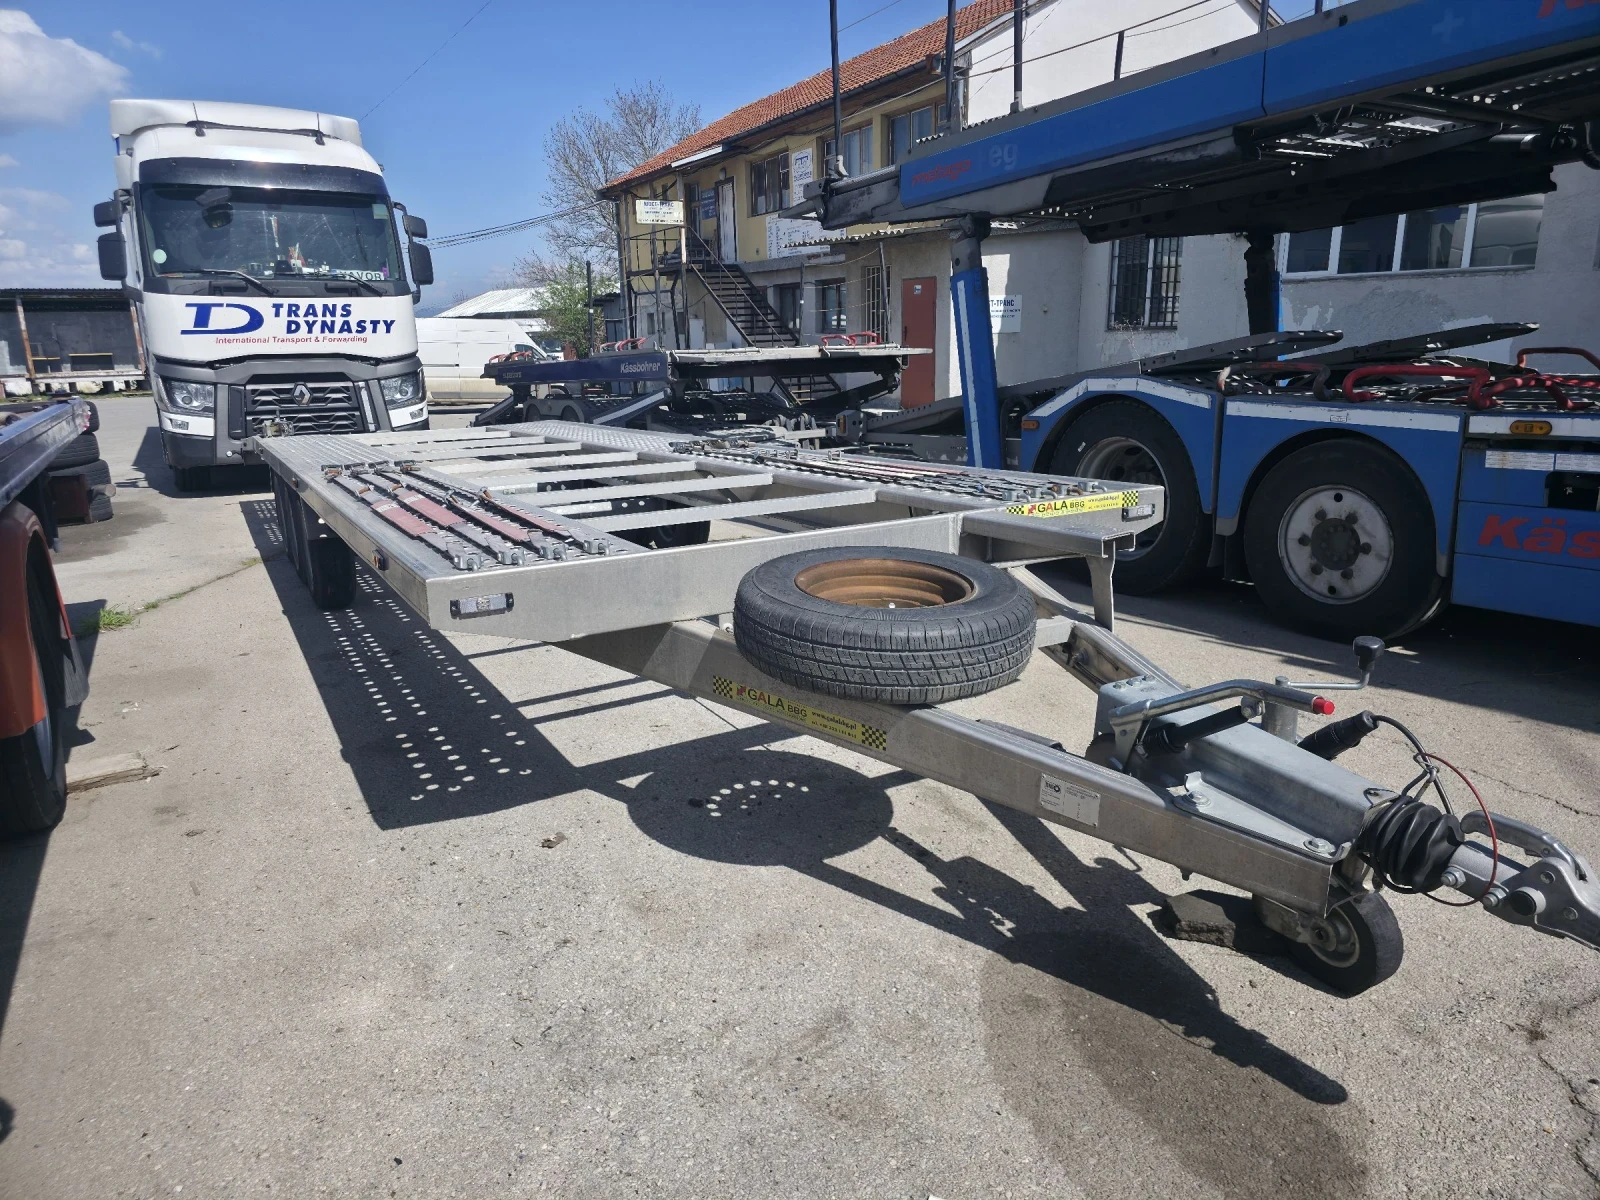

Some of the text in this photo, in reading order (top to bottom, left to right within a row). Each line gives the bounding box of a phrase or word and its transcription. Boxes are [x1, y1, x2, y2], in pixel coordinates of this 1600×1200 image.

[911, 160, 972, 188] metago
[271, 303, 353, 318] TRANS
[990, 299, 1015, 307] Т-ТРАНС
[286, 319, 396, 335] DYNASTY
[215, 336, 270, 344] International
[272, 336, 312, 344] Transport
[321, 335, 368, 344] Forwarding
[1037, 500, 1068, 513] GALA
[1069, 501, 1085, 509] BBG
[747, 688, 785, 711] GALA
[787, 704, 808, 718] BBG
